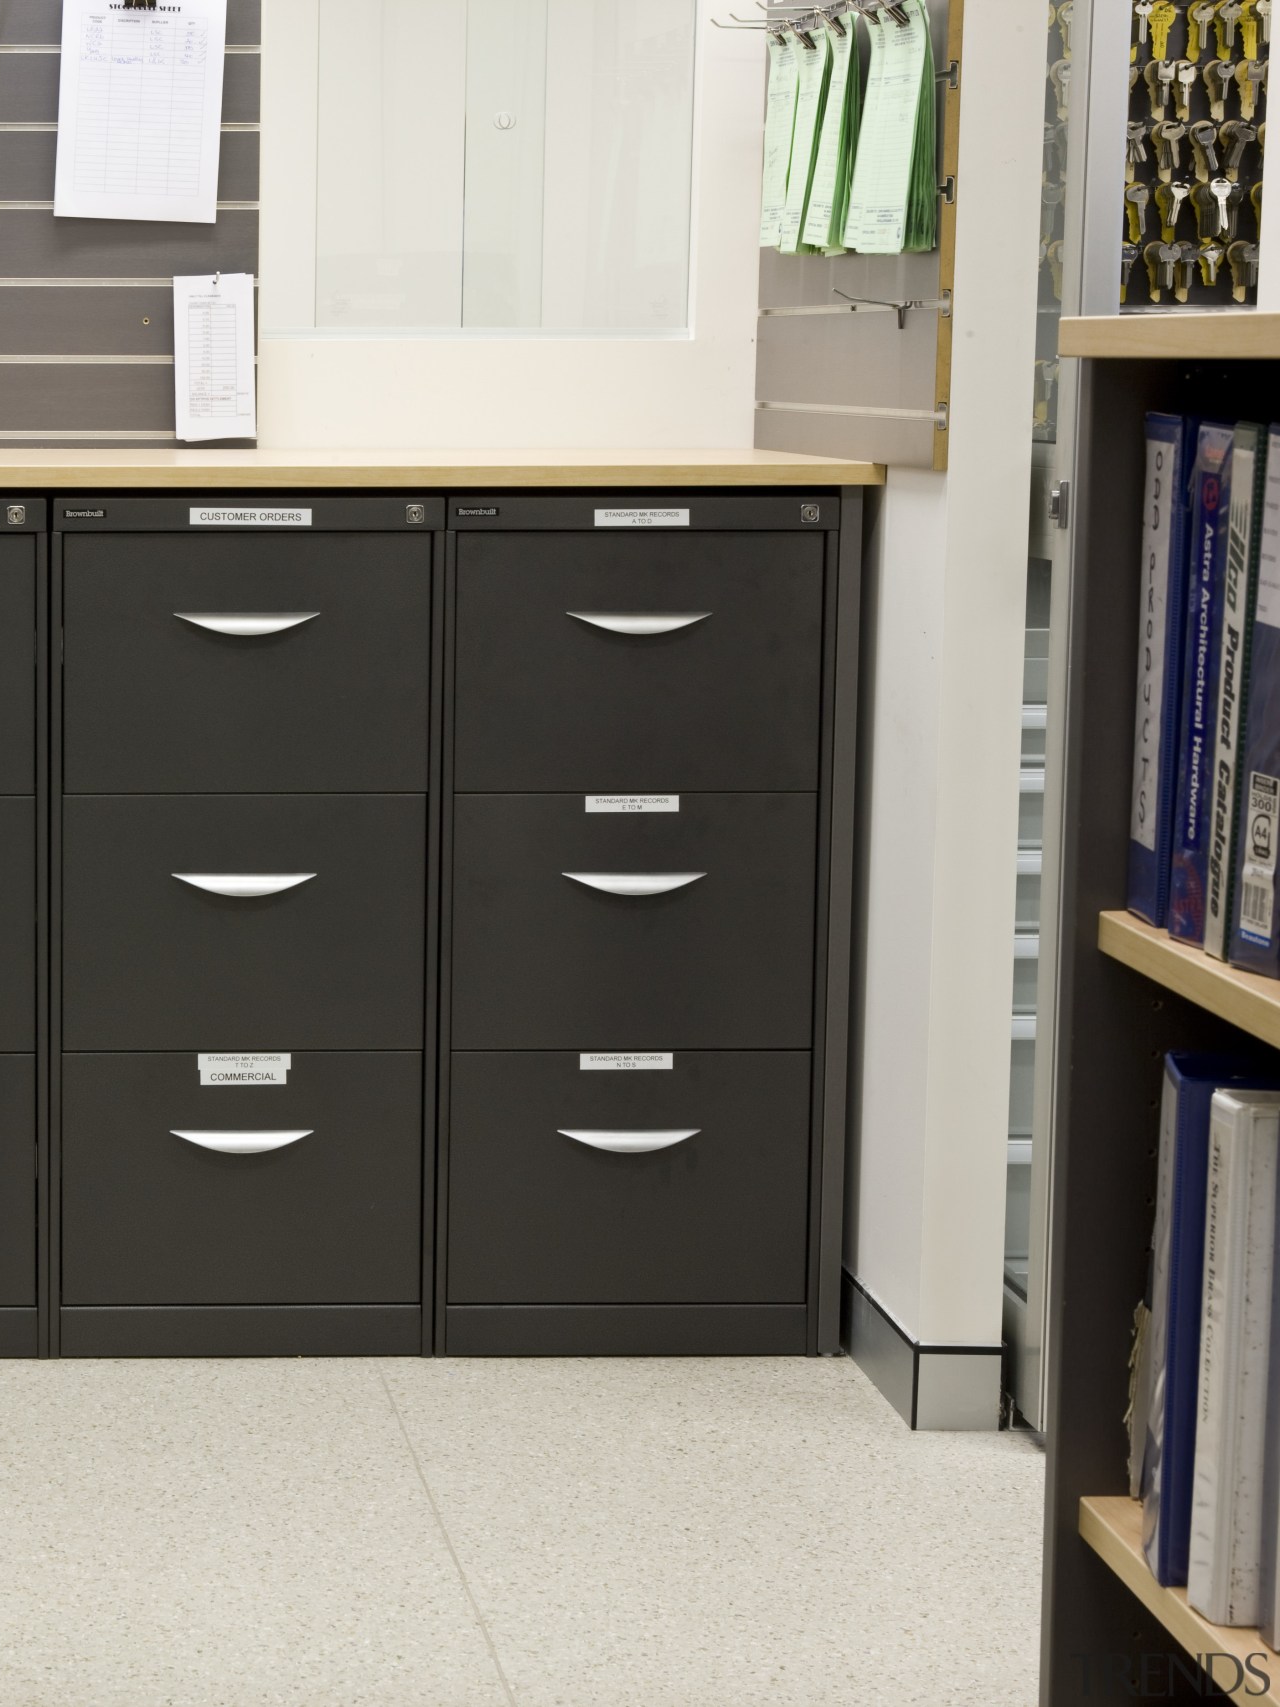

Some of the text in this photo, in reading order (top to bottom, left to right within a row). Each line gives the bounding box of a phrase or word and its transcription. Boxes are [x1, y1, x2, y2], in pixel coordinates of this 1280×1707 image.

[200, 512, 302, 522] CUSTOMER ORDERS
[1153, 451, 1163, 531] ODD
[1138, 552, 1156, 824] PRODUCTS
[1187, 522, 1214, 840] Astra Architectural Hardware
[1220, 624, 1239, 750] Product
[1210, 759, 1230, 918] Catalogue
[1251, 796, 1272, 812] 300
[1254, 824, 1268, 839] A4
[210, 1073, 276, 1082] COMMERCIAL
